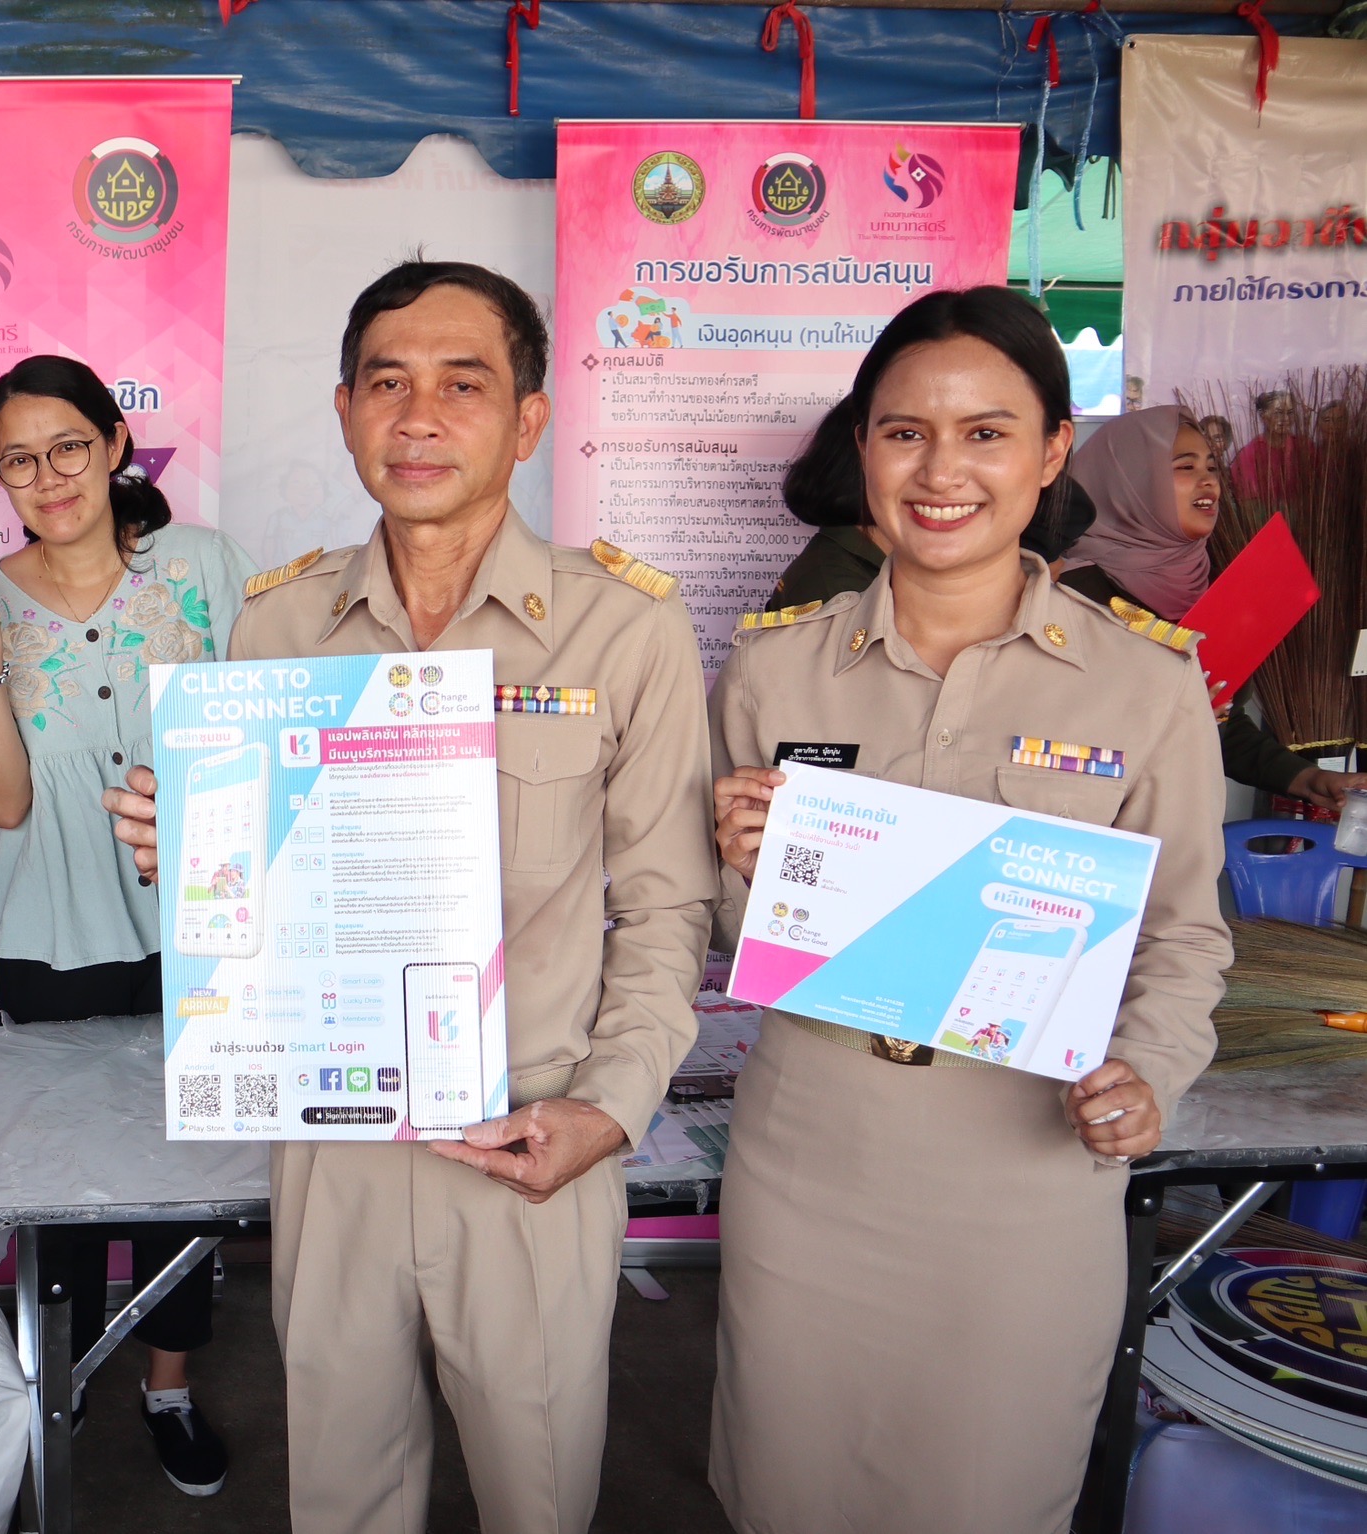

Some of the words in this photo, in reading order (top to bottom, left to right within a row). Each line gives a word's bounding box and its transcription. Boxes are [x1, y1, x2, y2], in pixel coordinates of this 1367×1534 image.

[745, 209, 830, 239] กรมการพัฒนาชุมชน
[870, 219, 946, 232] บทบาทสตรี
[66, 220, 185, 261] กรมการพัฒนาชุมชน
[634, 254, 933, 293] การขอรับการสนับสนุน
[698, 324, 792, 347] เงินอุดหนุน
[8, 346, 33, 354] Funds
[602, 353, 664, 370] คุณสมบัติ
[612, 373, 758, 387] เป็นสมาชิกประเภทองค์กรสตรี
[611, 408, 796, 426] ขอรับการสนับสนุนไม่น้อยกว่าหกเดือน
[601, 438, 738, 457] การขอรับการสนับสนุน
[610, 457, 790, 476] เป็นโครงการที่ใช้จ่ายตามวัตถุประสงค์
[610, 477, 784, 493] คณะกรรมการบริหารกองทุนพัฒนาบ
[746, 533, 789, 546] 200,000
[182, 669, 266, 694] CLICK
[271, 667, 311, 690] TO
[203, 694, 342, 721] CONNECT
[441, 705, 454, 713] for
[456, 704, 480, 713] Good
[174, 731, 231, 746] คลิกชุมชน
[328, 728, 399, 742] แอปพลิเคชัน
[403, 727, 460, 740] คลิกชุมชน
[328, 746, 438, 762] มีเมนูบริการมากกว่า
[442, 745, 456, 756] 13
[460, 745, 482, 757] เมนู
[796, 794, 898, 826] แอปพลิเคชัน
[792, 812, 880, 841] คลิกชุมชน
[990, 836, 1060, 866] CLICK
[1064, 851, 1097, 873] TO
[1001, 861, 1117, 900] CONNECT
[994, 890, 1081, 919] คลิกชุมชน
[811, 937, 828, 947] Good
[363, 977, 382, 985] Login
[183, 1000, 225, 1011] ARRIVAL
[343, 1015, 381, 1023] Membership
[210, 1040, 285, 1054] เข้าสู่ระบบด้วย
[289, 1041, 325, 1052] Smart
[330, 1041, 365, 1054] Login
[325, 1112, 340, 1120] Sign
[361, 1112, 382, 1120] Apple
[188, 1125, 203, 1133] Play
[204, 1124, 225, 1132] Store
[245, 1125, 259, 1133] App
[260, 1124, 281, 1132] Store
